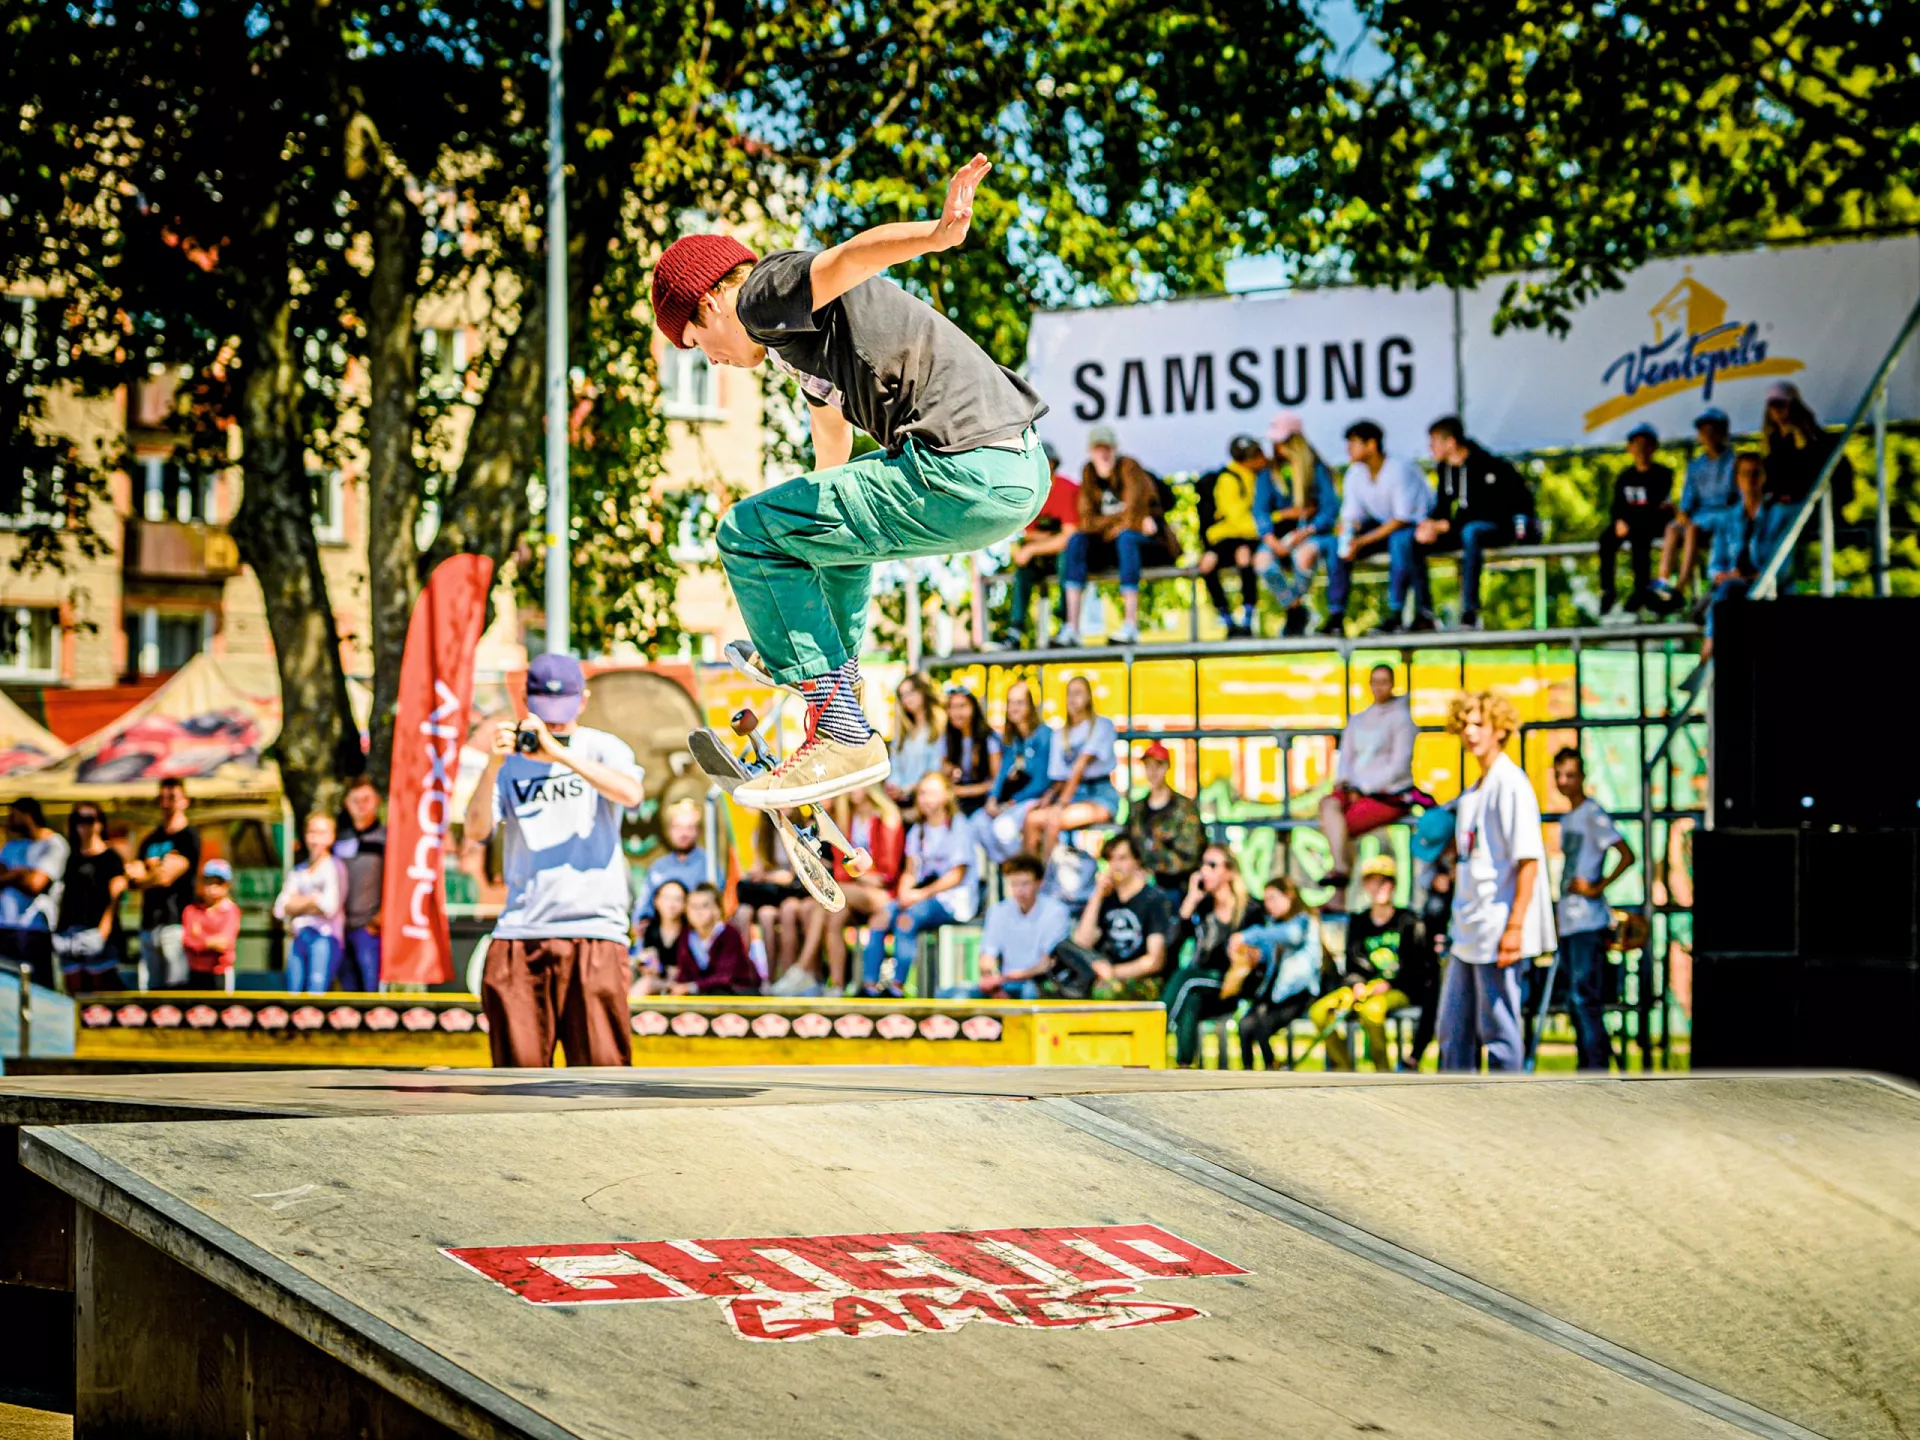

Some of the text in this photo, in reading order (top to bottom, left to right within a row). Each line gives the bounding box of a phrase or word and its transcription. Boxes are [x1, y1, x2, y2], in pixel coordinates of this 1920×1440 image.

[1073, 335, 1414, 421] SAMSUNG
[512, 777, 583, 804] VANS
[440, 1224, 1255, 1303] GHETTO
[730, 1285, 1201, 1339] GAMES
